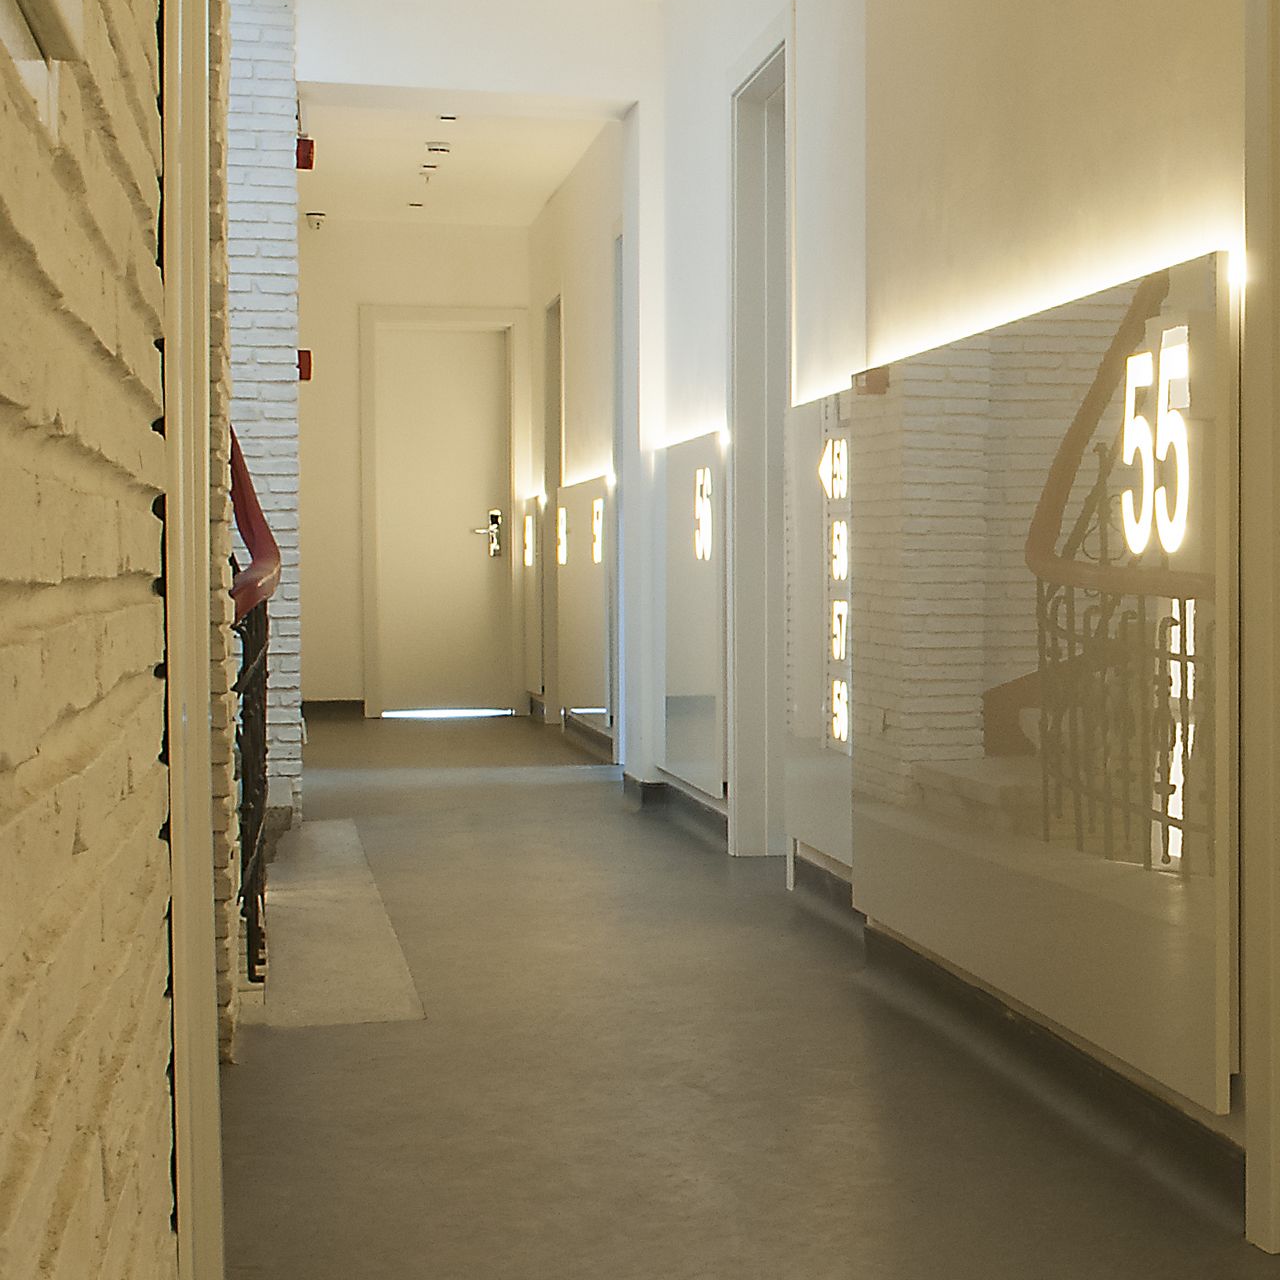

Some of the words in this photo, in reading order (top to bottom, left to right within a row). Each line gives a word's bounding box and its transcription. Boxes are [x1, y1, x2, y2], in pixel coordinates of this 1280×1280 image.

[1120, 338, 1190, 555] 55
[695, 466, 713, 562] 56
[832, 598, 848, 661] 57
[832, 679, 848, 742] 56
